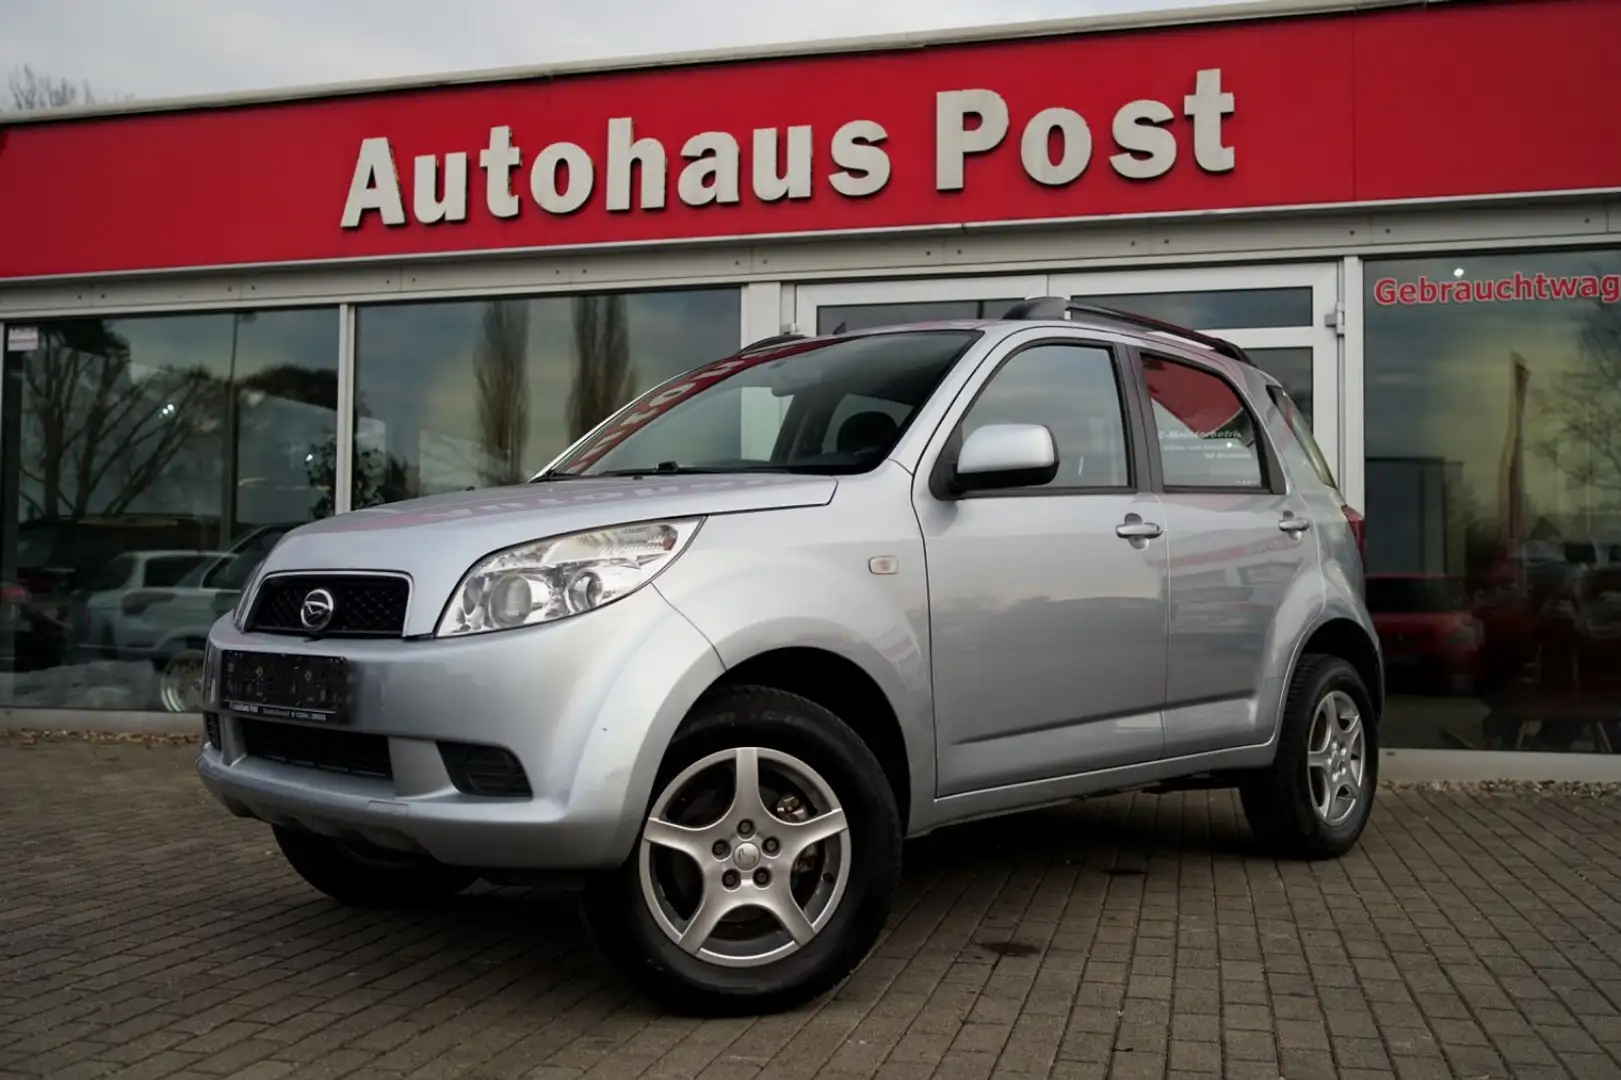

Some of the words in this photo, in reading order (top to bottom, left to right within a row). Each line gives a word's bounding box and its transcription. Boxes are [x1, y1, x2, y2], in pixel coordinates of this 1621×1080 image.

[341, 116, 891, 228] Autohaus
[936, 69, 1235, 191] Post
[1373, 272, 1621, 305] Gebrauchtwag
